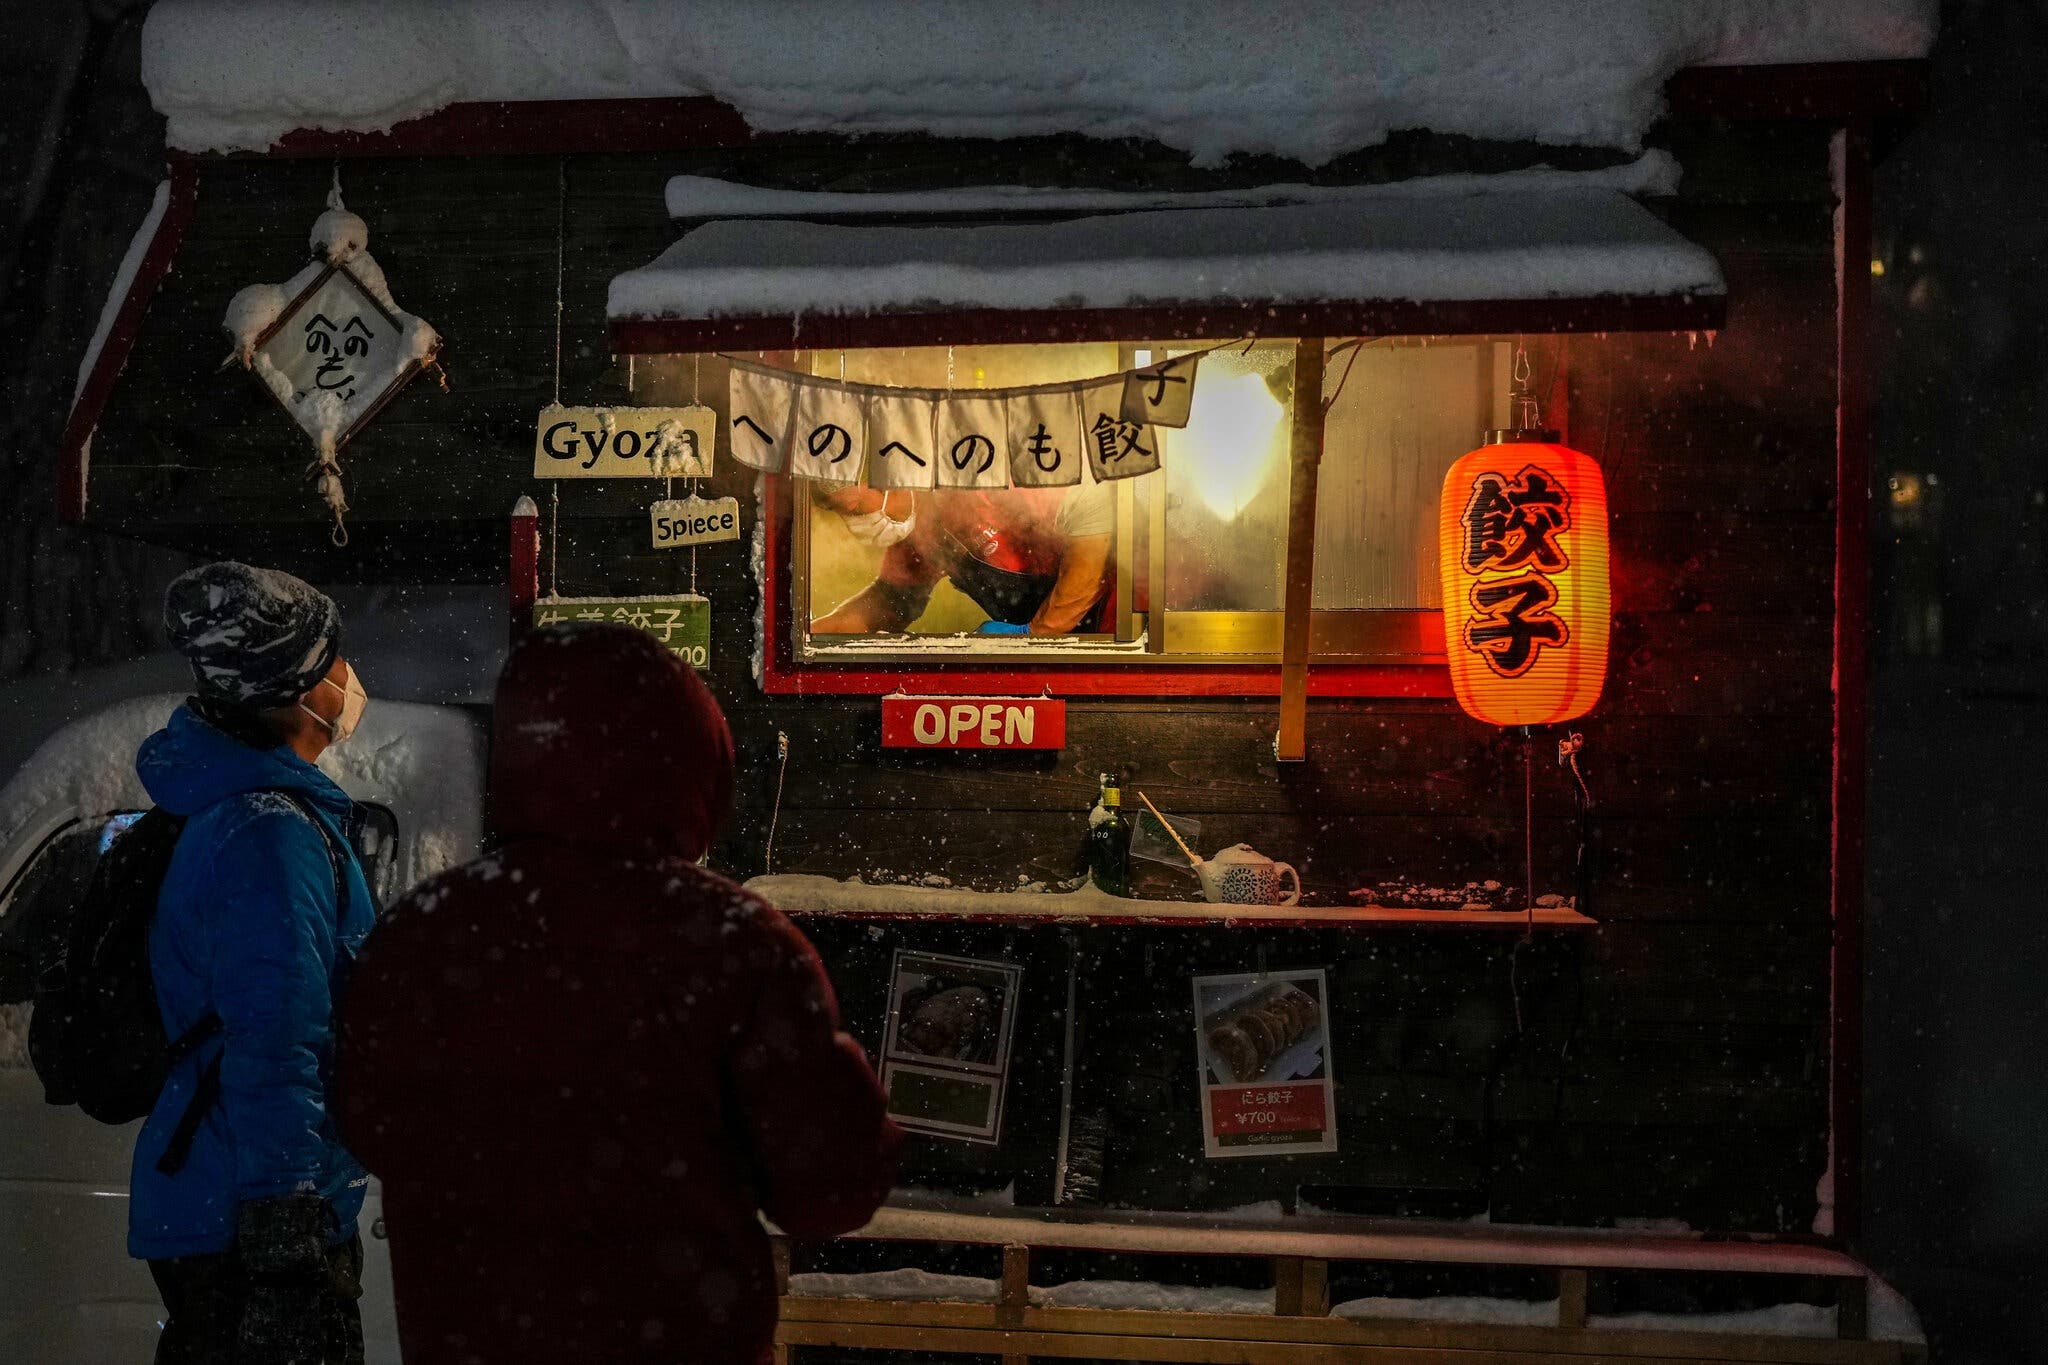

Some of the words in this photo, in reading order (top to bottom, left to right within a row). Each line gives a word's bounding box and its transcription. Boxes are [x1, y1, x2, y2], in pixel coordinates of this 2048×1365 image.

[1460, 464, 1571, 678] 餃子
[913, 703, 1036, 747] OPEN
[1237, 1111, 1276, 1125] ¥700
